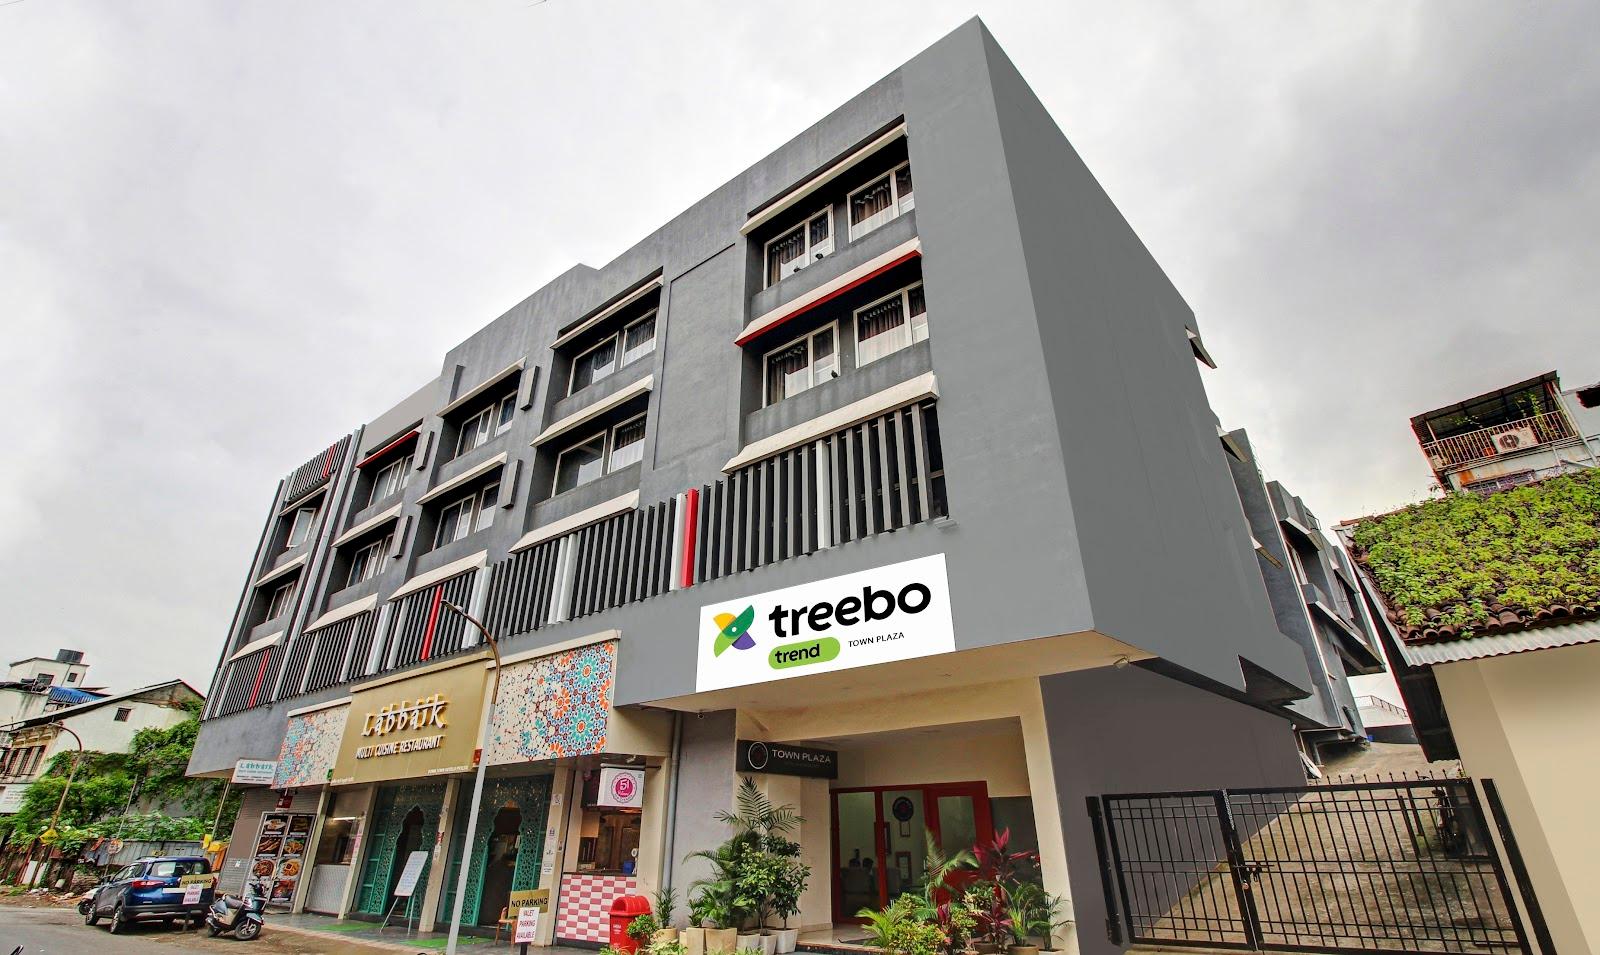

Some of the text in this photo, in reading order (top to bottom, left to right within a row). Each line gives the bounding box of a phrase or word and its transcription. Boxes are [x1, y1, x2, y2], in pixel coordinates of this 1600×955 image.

[768, 582, 932, 638] treebo
[848, 632, 905, 648] TOWN PLAZA
[775, 643, 820, 664] trend
[361, 693, 448, 737] Labbaik
[356, 735, 444, 759] MULTI CUISINE RESTAURANT
[772, 749, 831, 763] TOWN PLAZA
[511, 897, 548, 908] NO PARKING
[519, 920, 536, 928] PARKING
